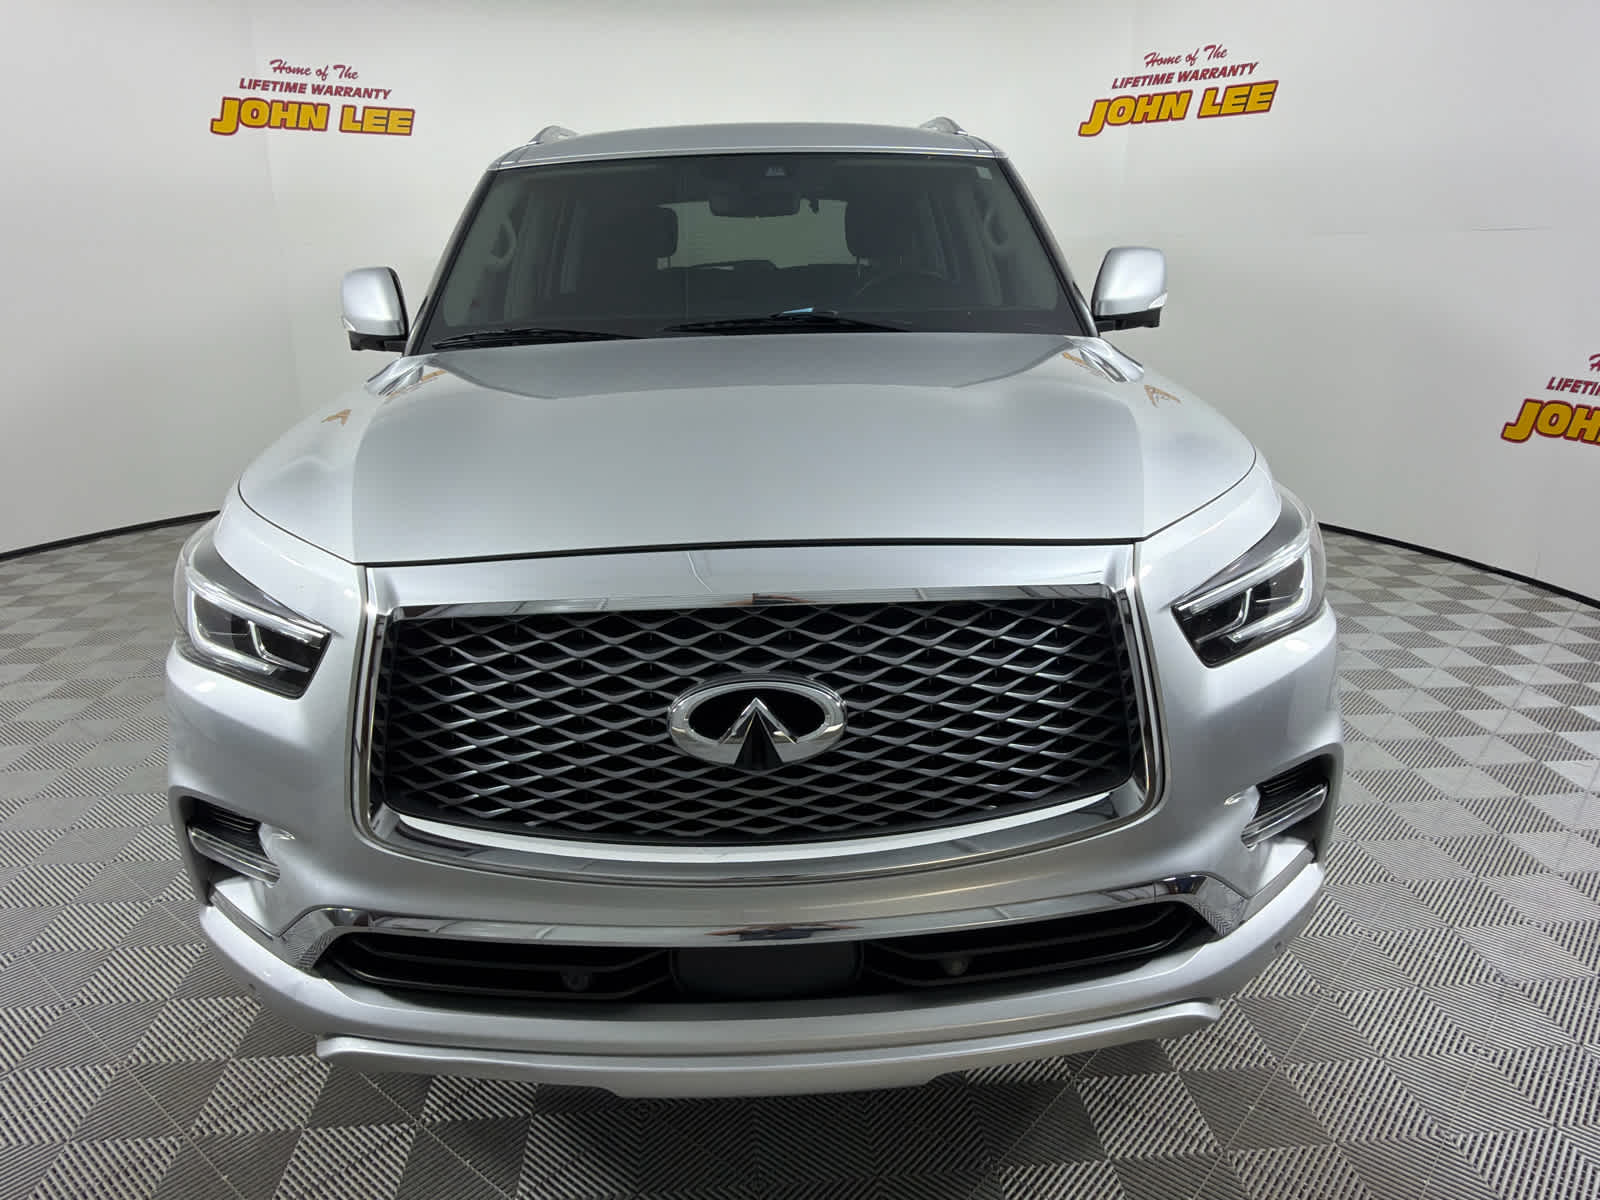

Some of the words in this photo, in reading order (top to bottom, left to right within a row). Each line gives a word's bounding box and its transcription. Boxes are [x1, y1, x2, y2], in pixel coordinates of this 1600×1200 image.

[1144, 52, 1181, 68] Home
[1185, 48, 1200, 66] of
[1204, 44, 1228, 60] The
[270, 59, 312, 76] Home
[315, 65, 329, 81] of
[333, 64, 359, 80] The
[1112, 72, 1174, 90] LIFETIME
[1178, 62, 1258, 83] WARRANTY
[239, 78, 307, 95] LIFETIME
[311, 83, 392, 100] WARRANTY
[210, 97, 330, 136] JOHN
[339, 104, 415, 136] LEE
[1078, 90, 1193, 137] JOHN
[1197, 80, 1279, 119] LEE
[1546, 376, 1600, 396] LIFETI
[1501, 398, 1600, 446] JOH
